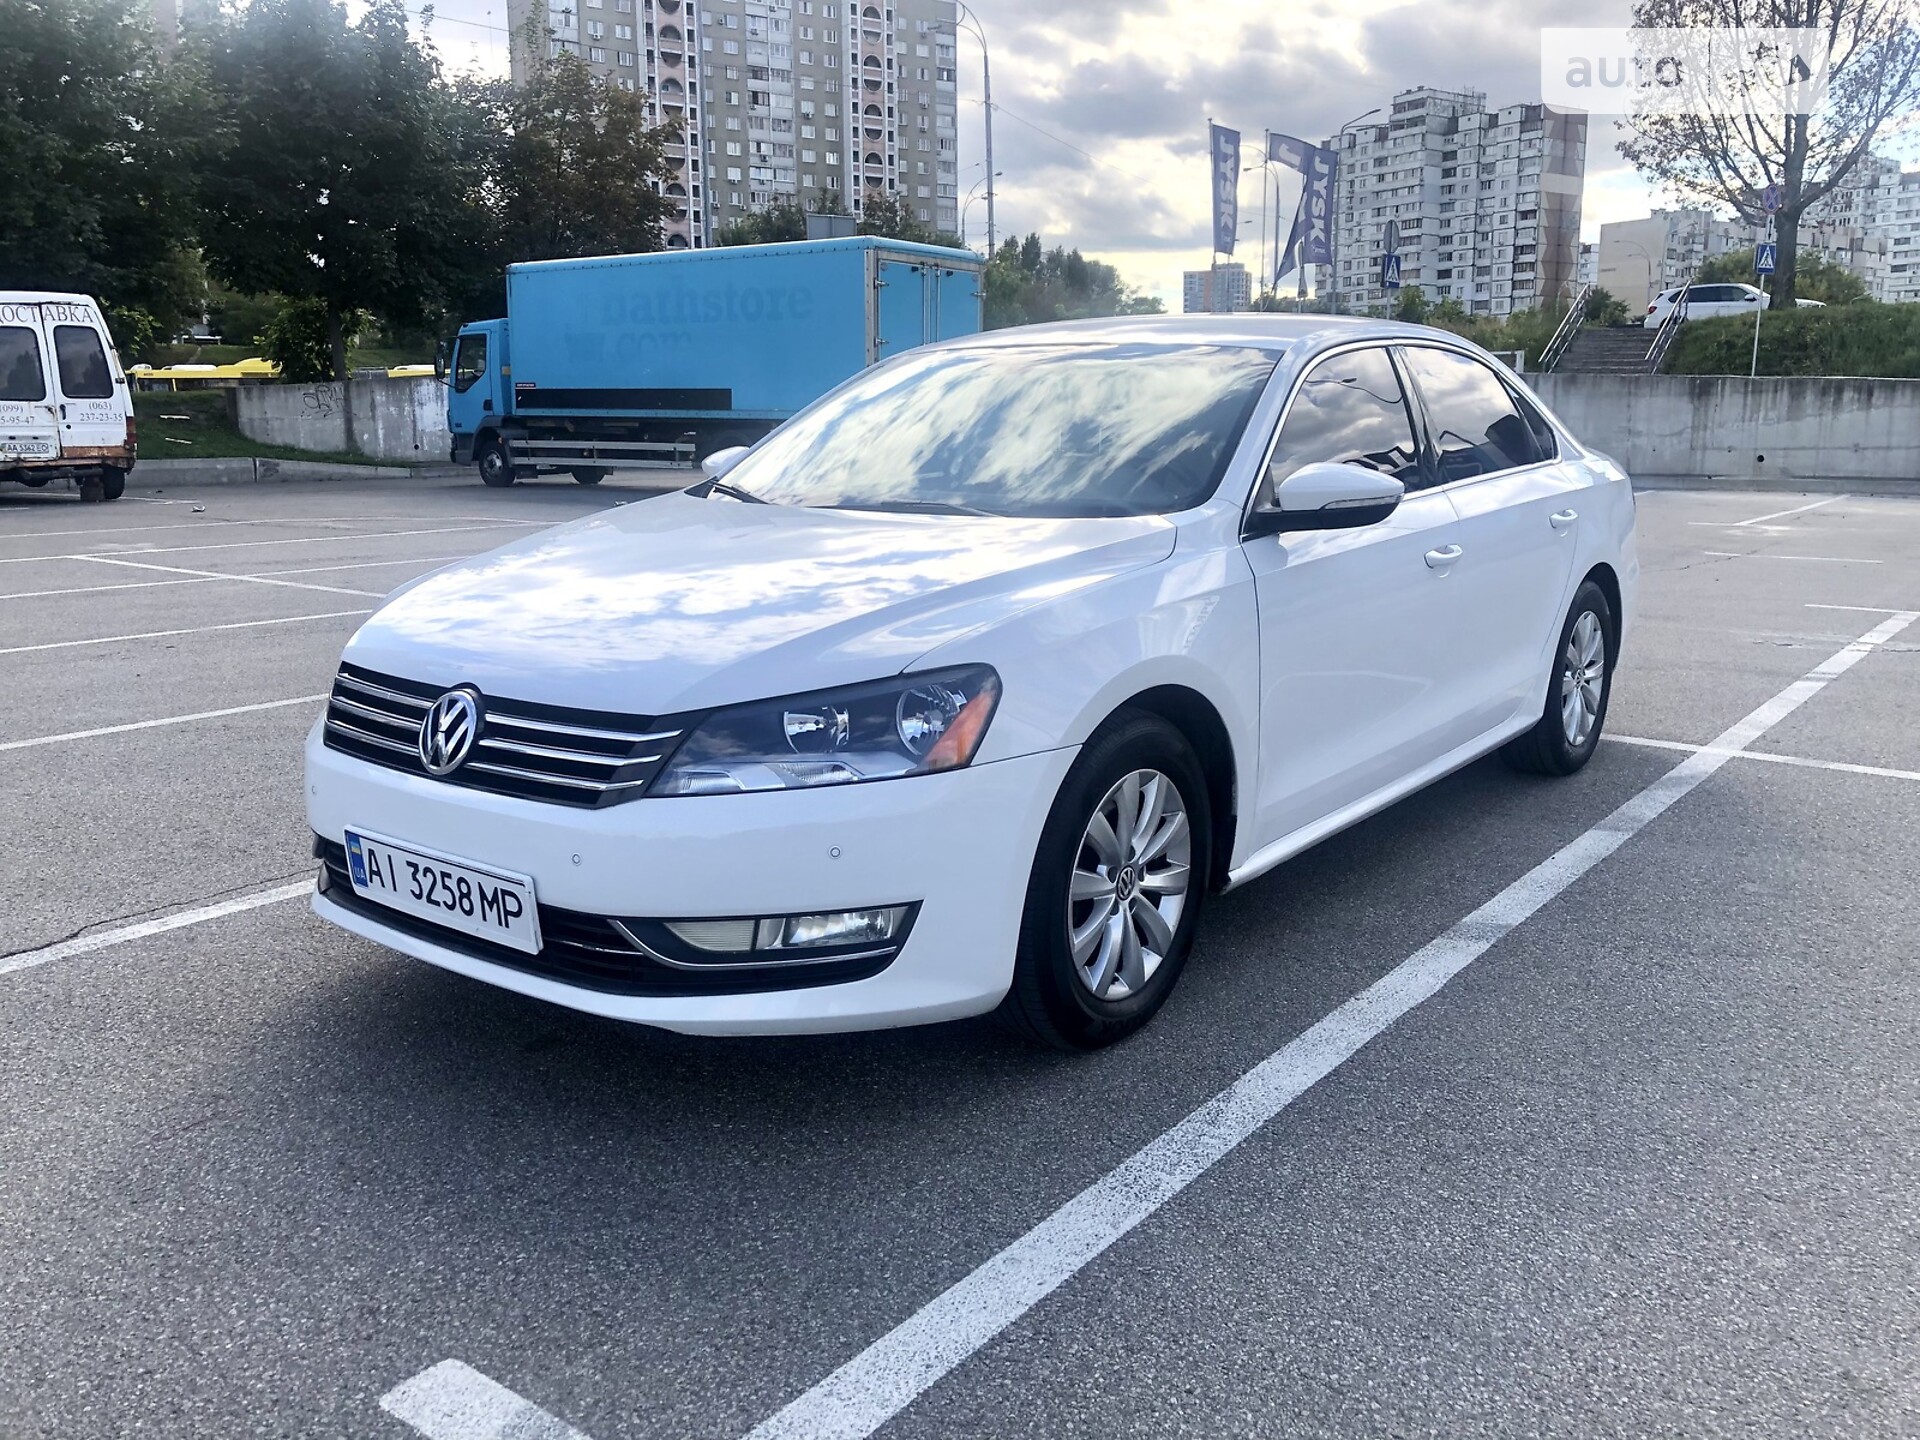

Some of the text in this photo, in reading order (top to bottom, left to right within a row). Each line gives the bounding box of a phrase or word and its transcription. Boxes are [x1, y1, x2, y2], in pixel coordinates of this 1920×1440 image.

[1219, 135, 1236, 230] JYSK
[1310, 155, 1330, 241] JYSK
[0, 305, 94, 323] ОСТАВКА
[88, 402, 112, 411] (063)
[80, 412, 123, 422] 237-23-35
[353, 866, 367, 880] UA
[368, 848, 523, 929] AI 3258 MP
